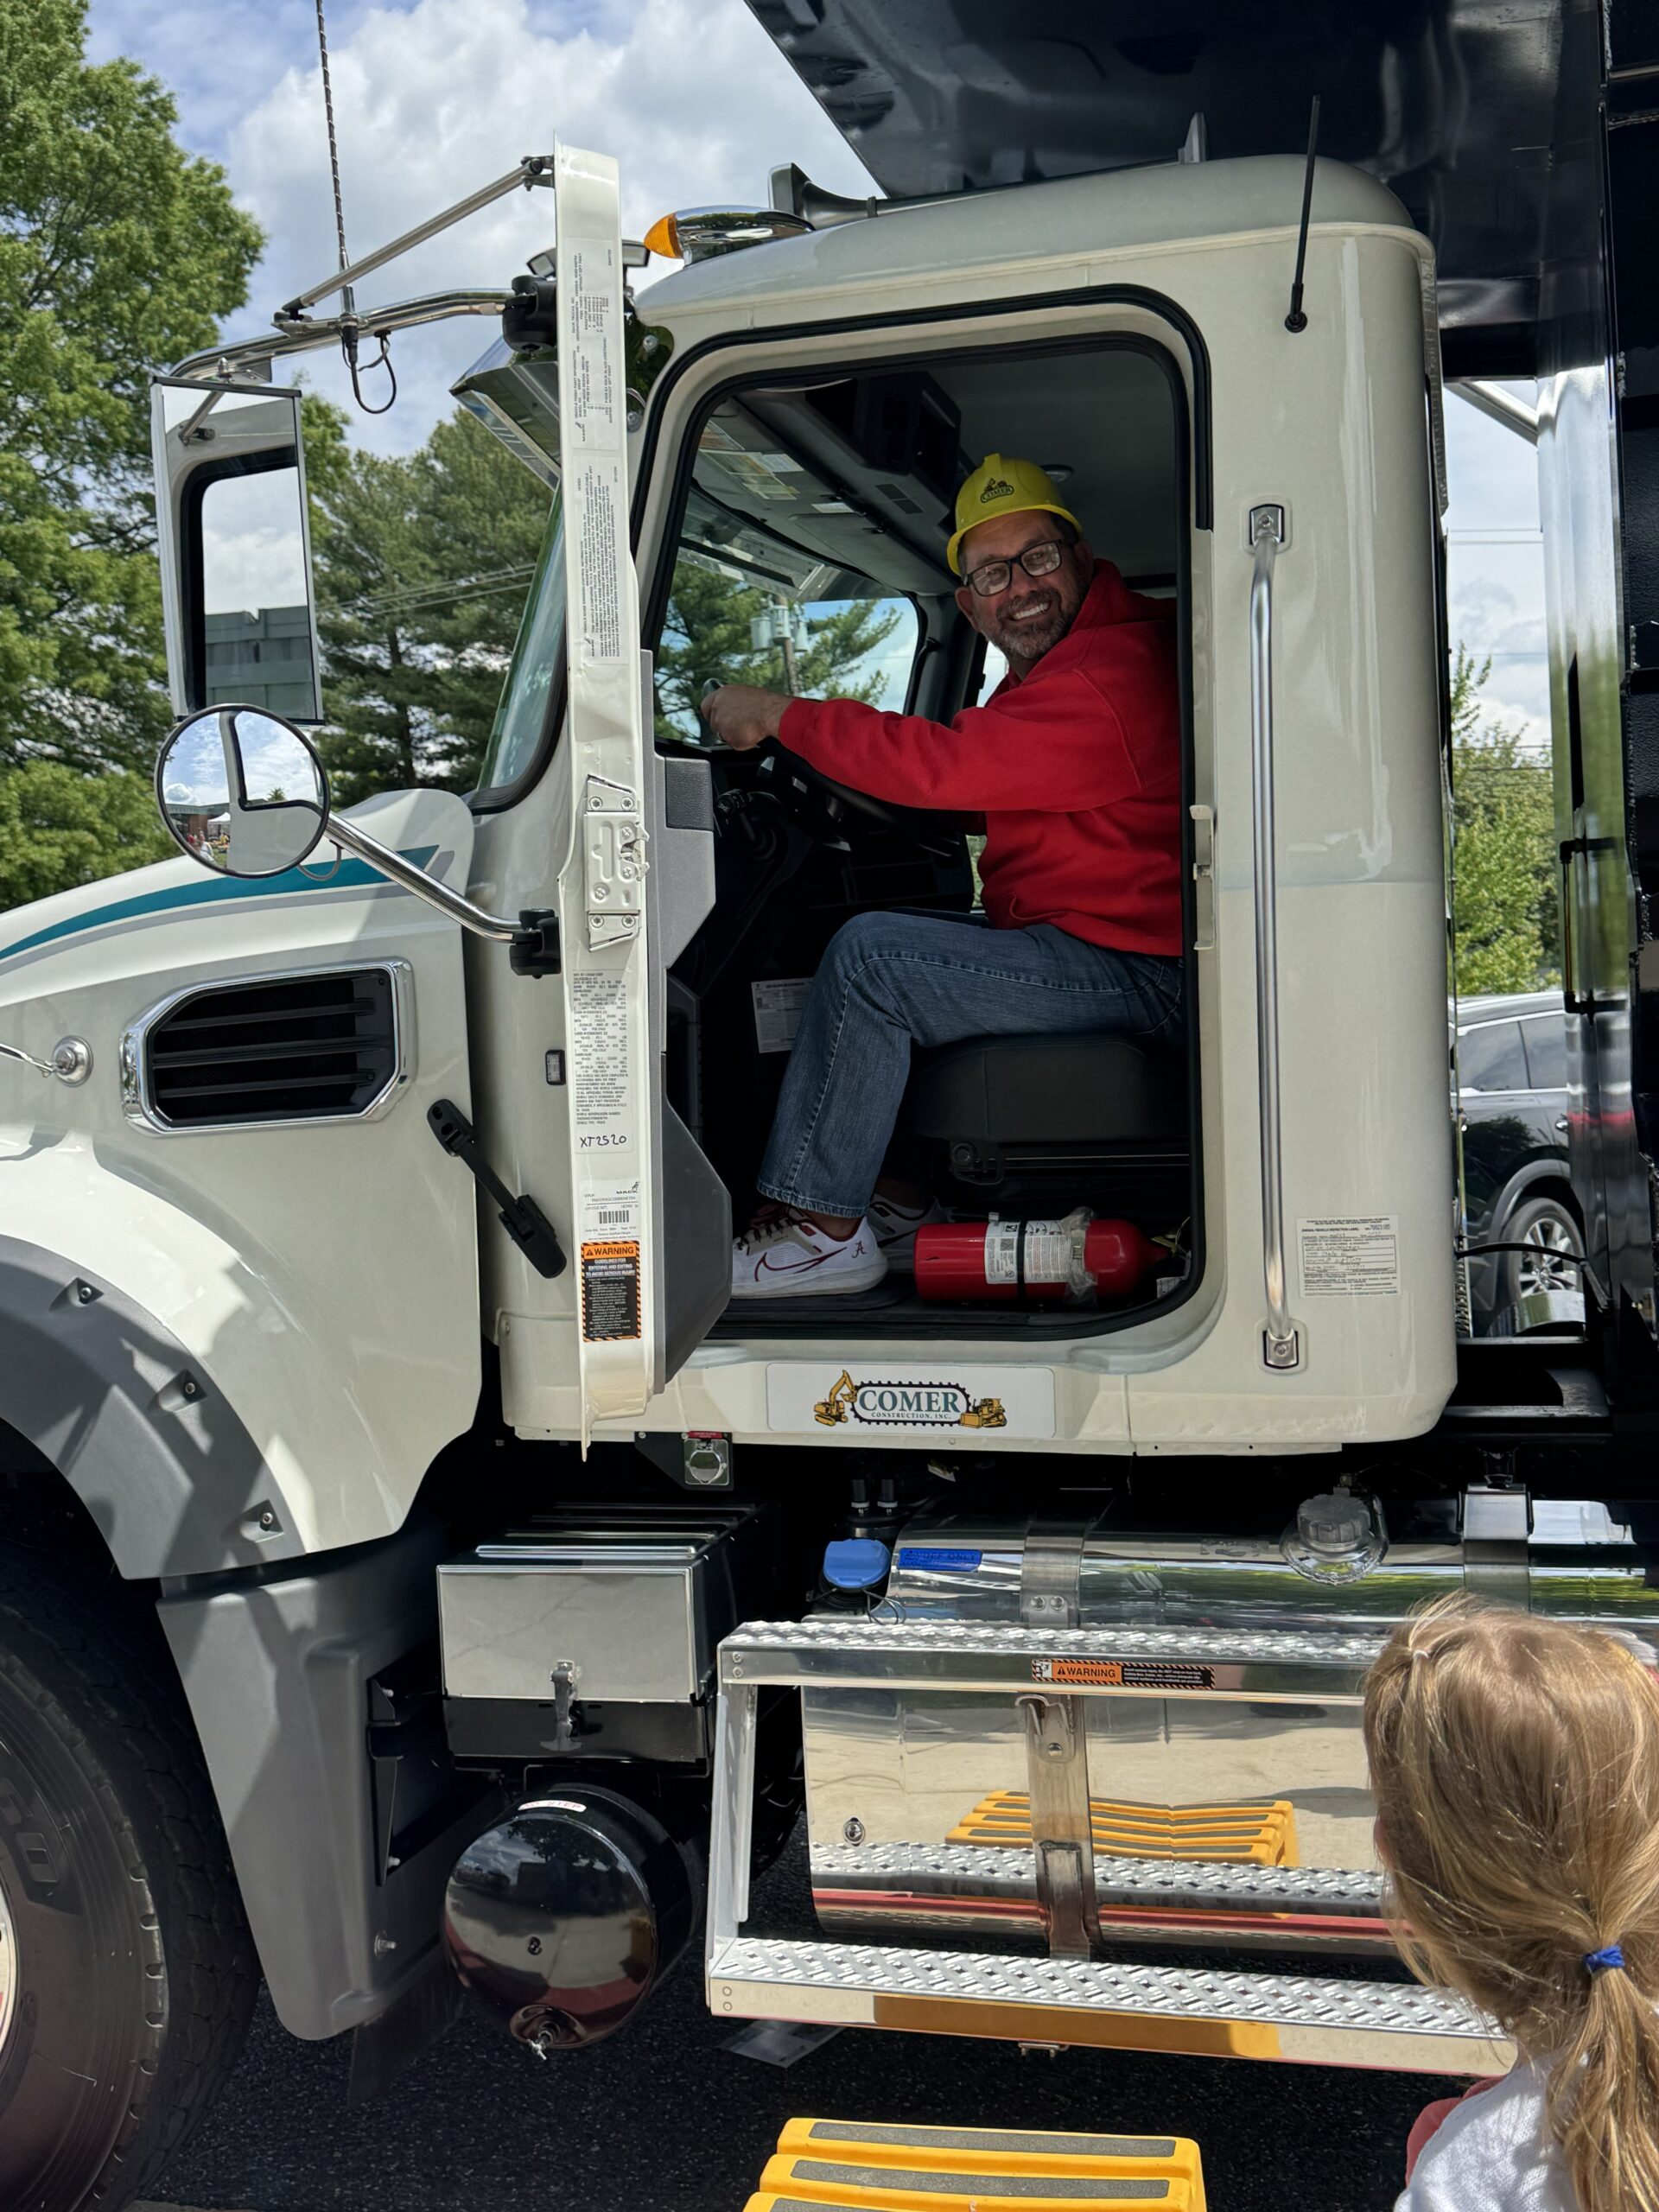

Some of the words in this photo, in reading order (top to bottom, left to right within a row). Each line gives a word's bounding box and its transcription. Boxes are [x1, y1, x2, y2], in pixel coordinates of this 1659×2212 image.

[982, 486, 1013, 501] COMER
[580, 1134, 627, 1148] XT2520
[594, 1246, 634, 1255] WARNING
[859, 1389, 961, 1413] COMER
[1067, 1667, 1116, 1678] WARNING
